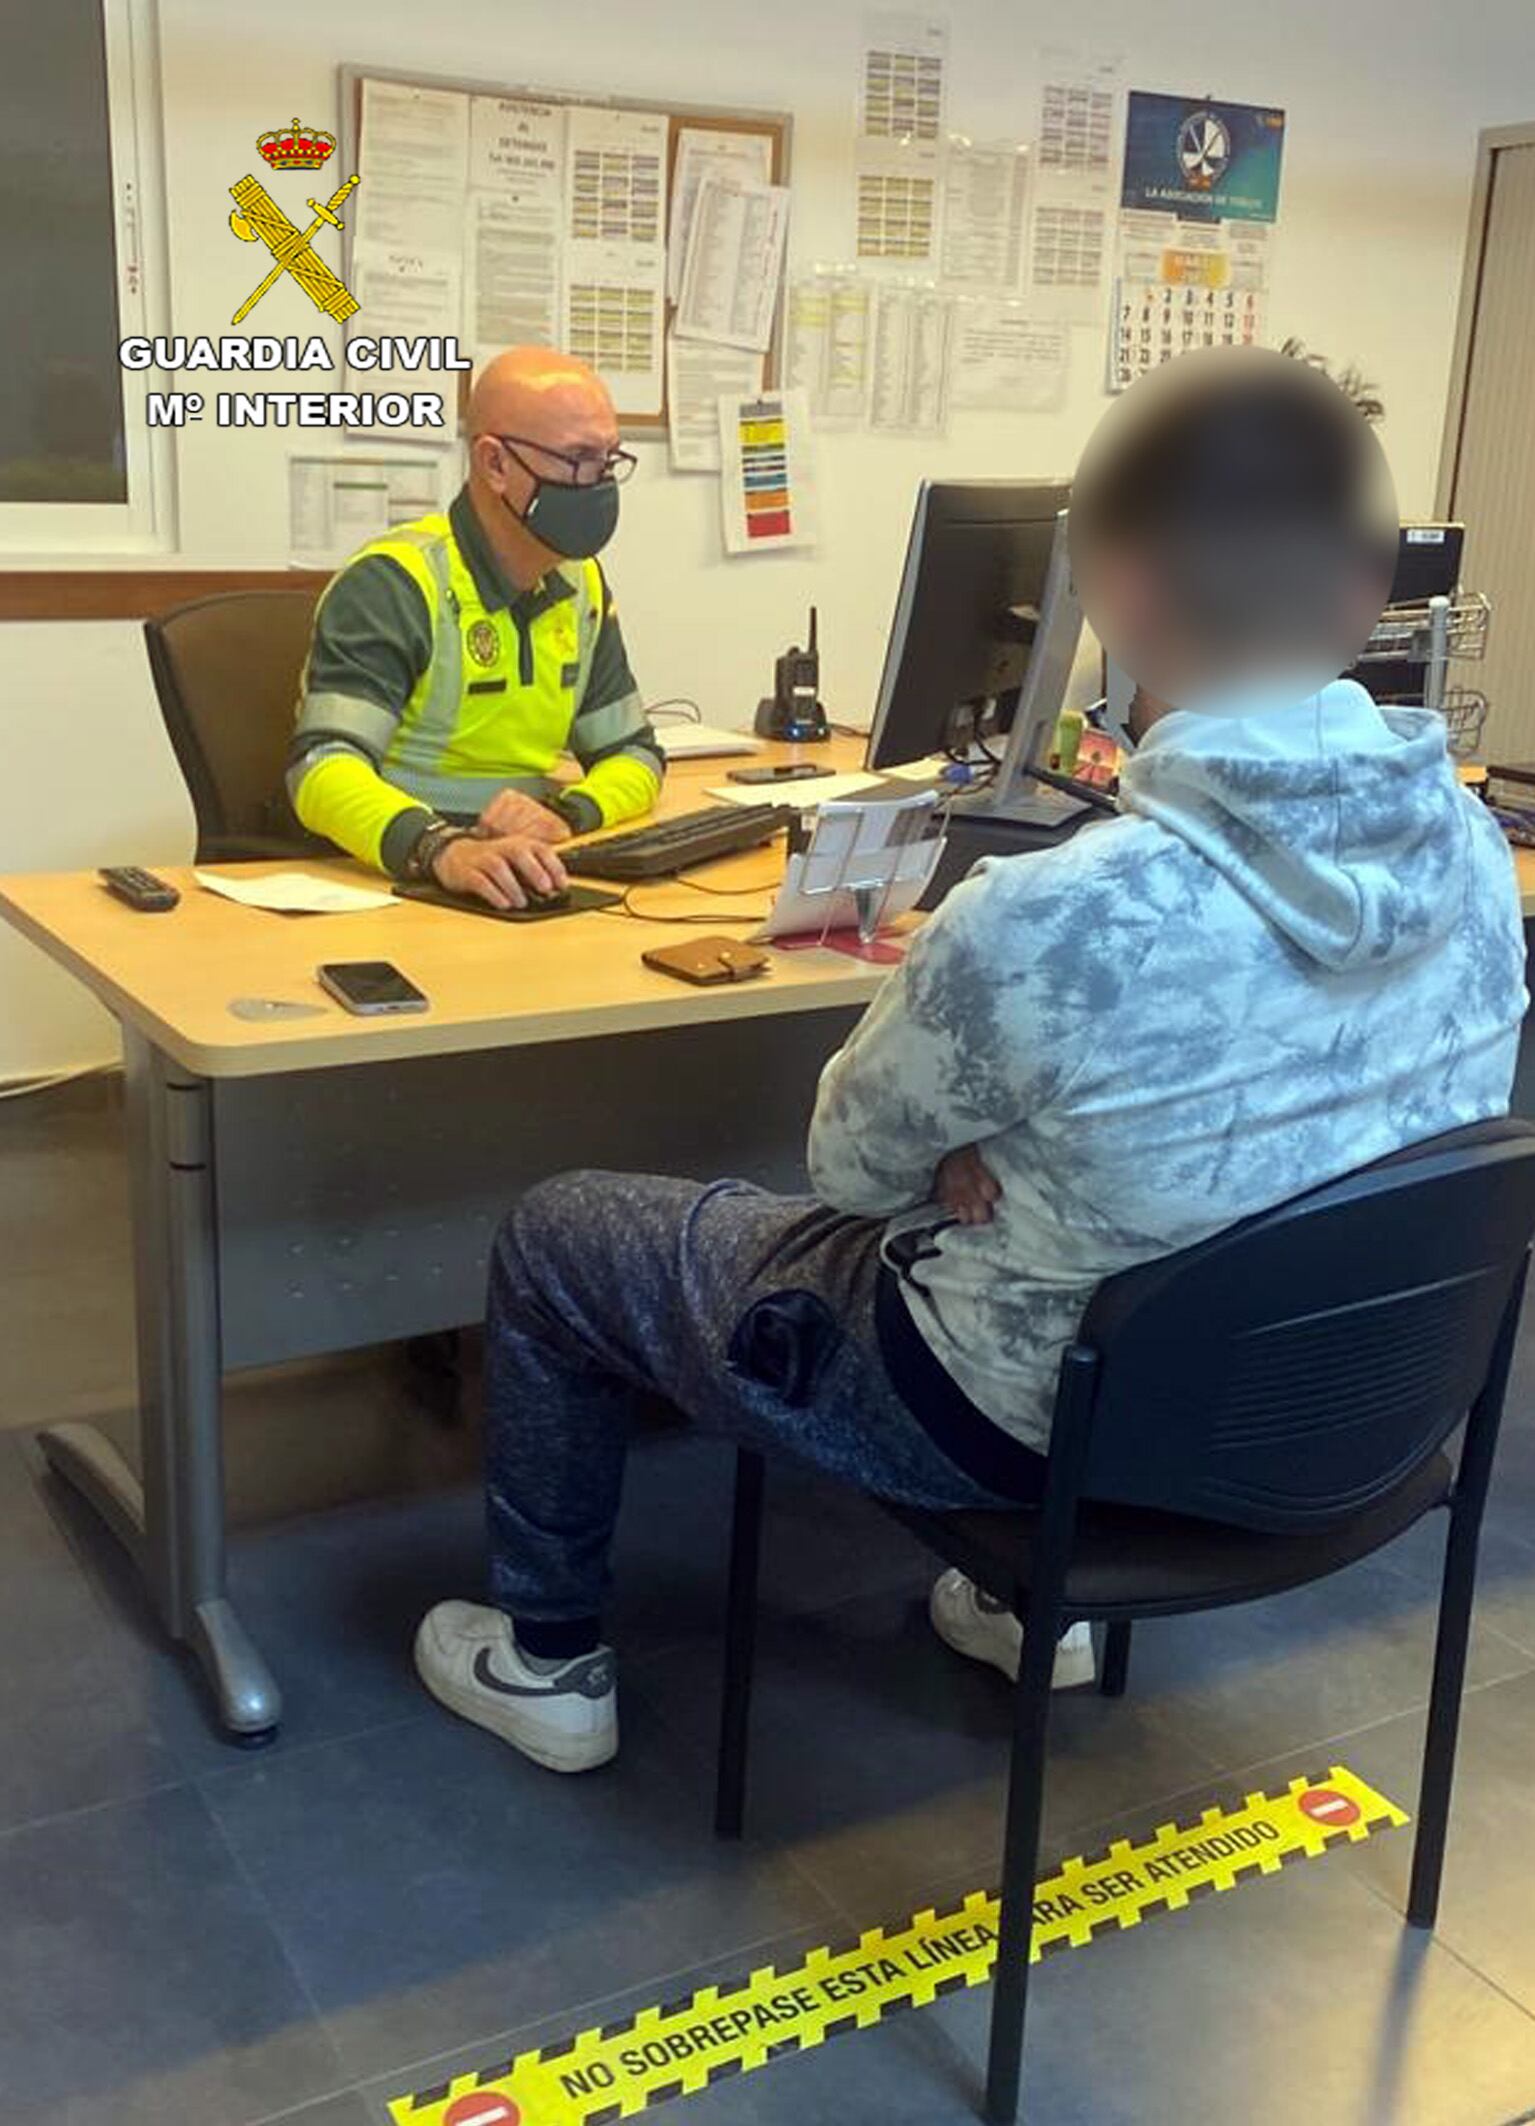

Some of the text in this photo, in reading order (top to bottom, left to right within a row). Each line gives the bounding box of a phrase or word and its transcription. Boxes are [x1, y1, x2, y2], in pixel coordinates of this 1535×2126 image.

[1183, 310, 1194, 326] 10
[1204, 311, 1214, 327] 11
[1224, 313, 1234, 328] 12
[1120, 327, 1131, 341] 14
[1141, 328, 1151, 343] 15
[1182, 330, 1193, 345] 17
[1120, 348, 1130, 363] 21
[560, 2062, 615, 2099] NO
[620, 1986, 820, 2077] SOBREPASE
[817, 1958, 903, 2004] ESTA
[906, 1923, 999, 1971] LÍNEA
[1080, 1870, 1145, 1907] SER
[1149, 1820, 1280, 1886] ATENDIDO
